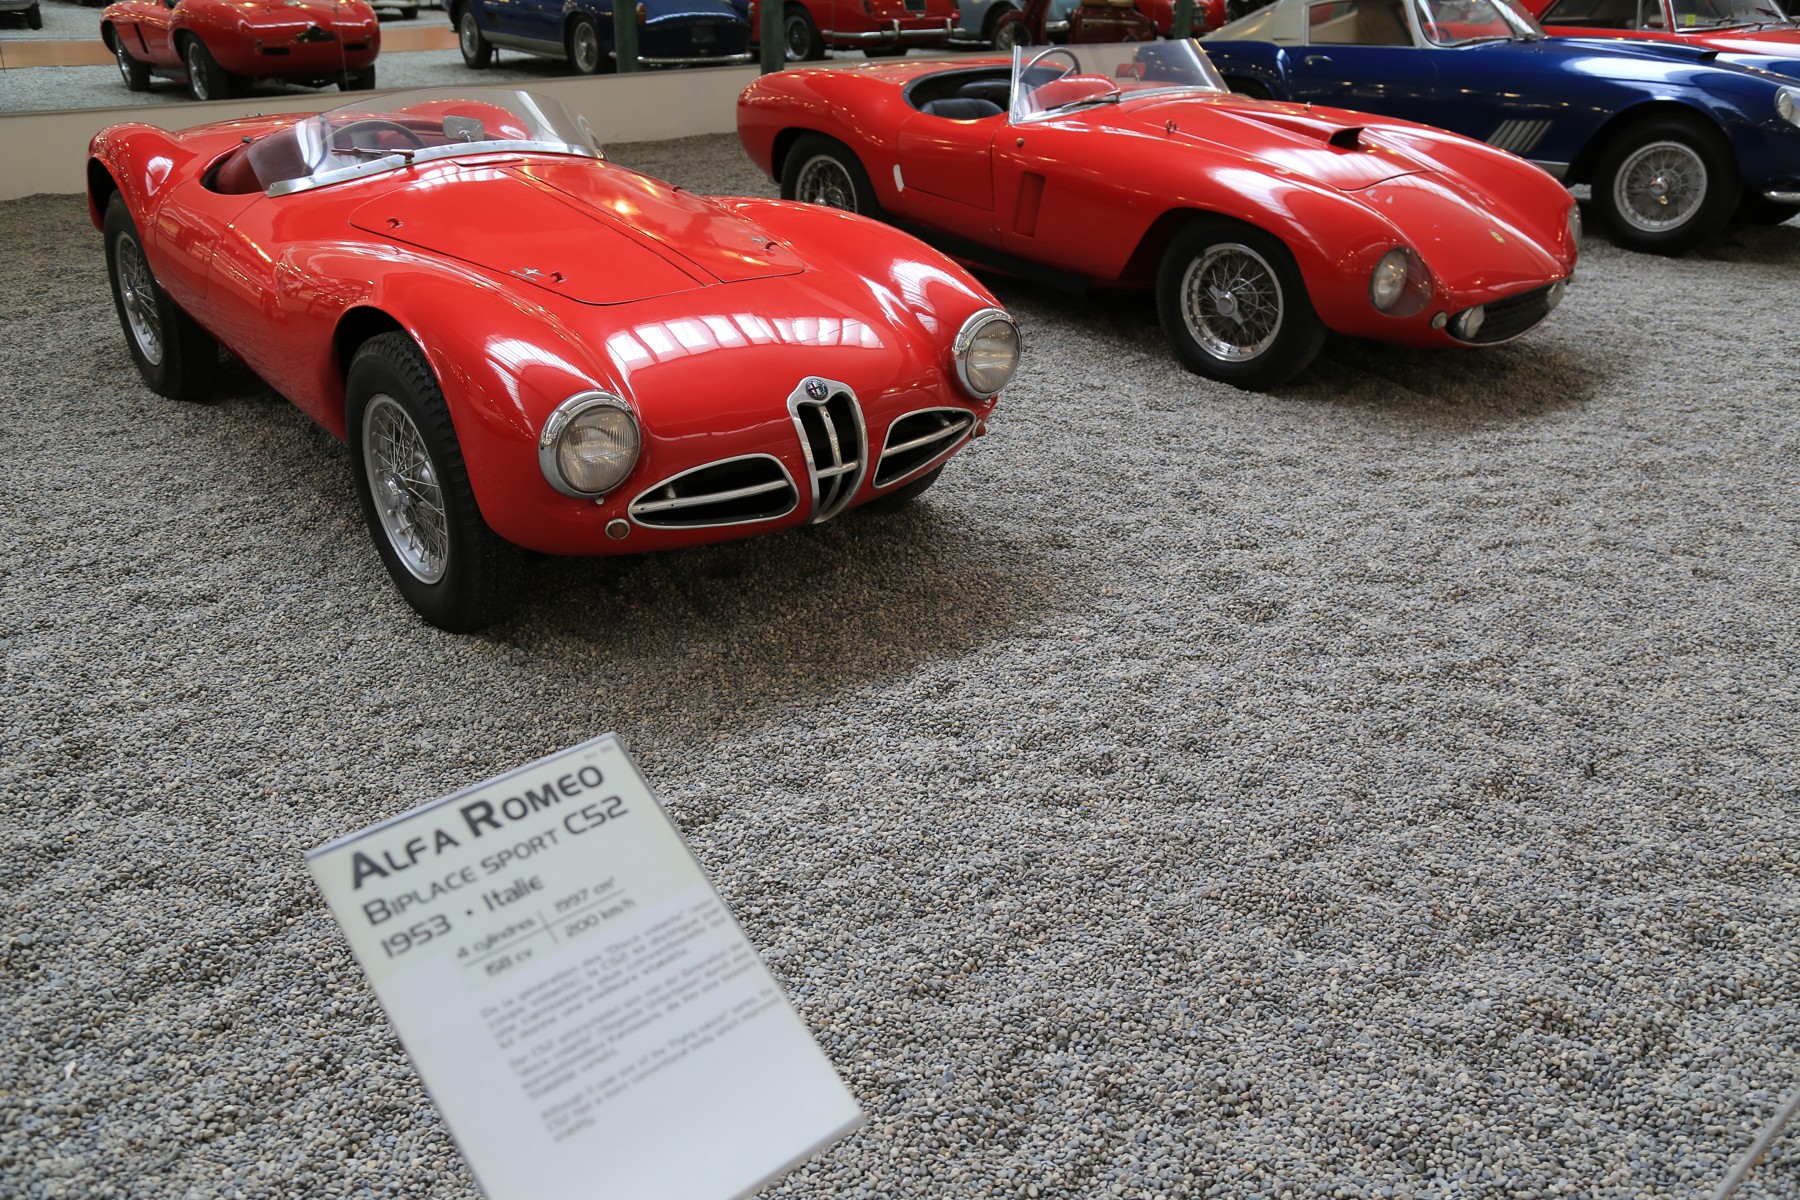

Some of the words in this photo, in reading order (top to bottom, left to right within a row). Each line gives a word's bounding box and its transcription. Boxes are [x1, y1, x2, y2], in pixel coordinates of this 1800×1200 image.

[352, 829, 460, 890] ALFA
[460, 765, 605, 838] ROMEO
[361, 865, 477, 926] BIPLACE
[480, 826, 560, 876] SPORT
[563, 795, 629, 835] C52
[379, 913, 452, 958] 1953
[481, 874, 545, 911] Italie
[473, 917, 536, 951] cylindres
[565, 914, 599, 938] 200
